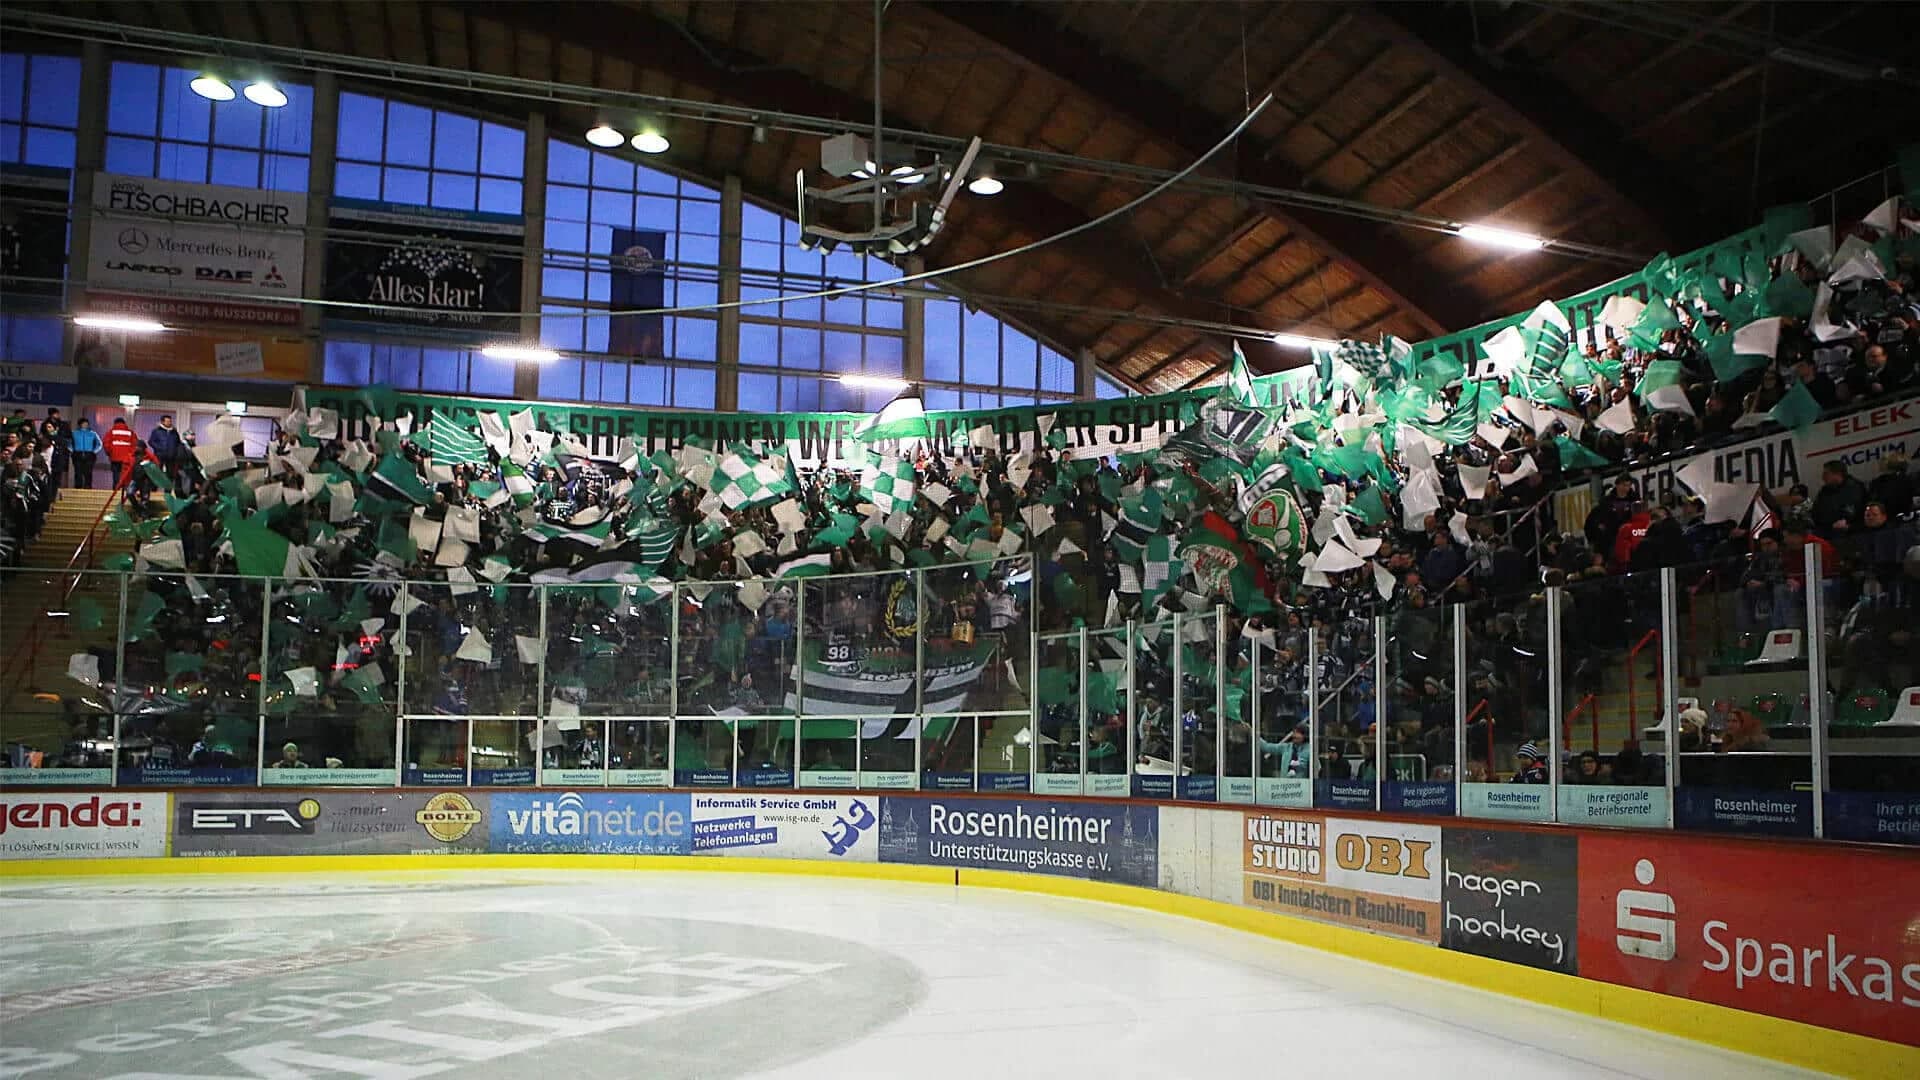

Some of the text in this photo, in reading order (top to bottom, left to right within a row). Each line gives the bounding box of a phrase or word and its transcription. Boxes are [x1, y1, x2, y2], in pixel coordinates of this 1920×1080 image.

[110, 191, 289, 224] FISCHBACHER
[195, 267, 252, 280] DAF
[368, 275, 425, 304] Alles
[1834, 399, 1920, 436] ELEK
[828, 645, 850, 661] 98
[1332, 785, 1370, 796] Rosenheimer
[1487, 791, 1541, 803] Rosenheimer
[1587, 790, 1649, 804] Ihre regionale
[696, 798, 837, 810] Informatik Service GmbH
[1588, 804, 1652, 816] Betriebsrente!
[1714, 799, 1797, 814] Rosenheimer
[1877, 802, 1904, 816] Ihre
[192, 809, 302, 829] ETA
[423, 812, 475, 821] BOLTE
[508, 799, 683, 836] vitanet.de
[763, 814, 820, 826] www.isg-ro.de
[930, 804, 1112, 845] Rosenheimer
[695, 820, 751, 834] Netzwerke
[1247, 815, 1321, 848] KÜCHEN
[65, 841, 100, 850] SERVICE
[105, 841, 140, 850] WISSEN
[694, 830, 774, 848] Telefonanlagen
[930, 840, 1112, 872] Unterstützungskasse e.V.
[1252, 844, 1321, 876] STUDIO
[1335, 833, 1432, 880] OBI
[1445, 858, 1542, 908] hager
[1252, 879, 1426, 935] OBI Inntalstern Raubling
[1445, 901, 1564, 964] hockey
